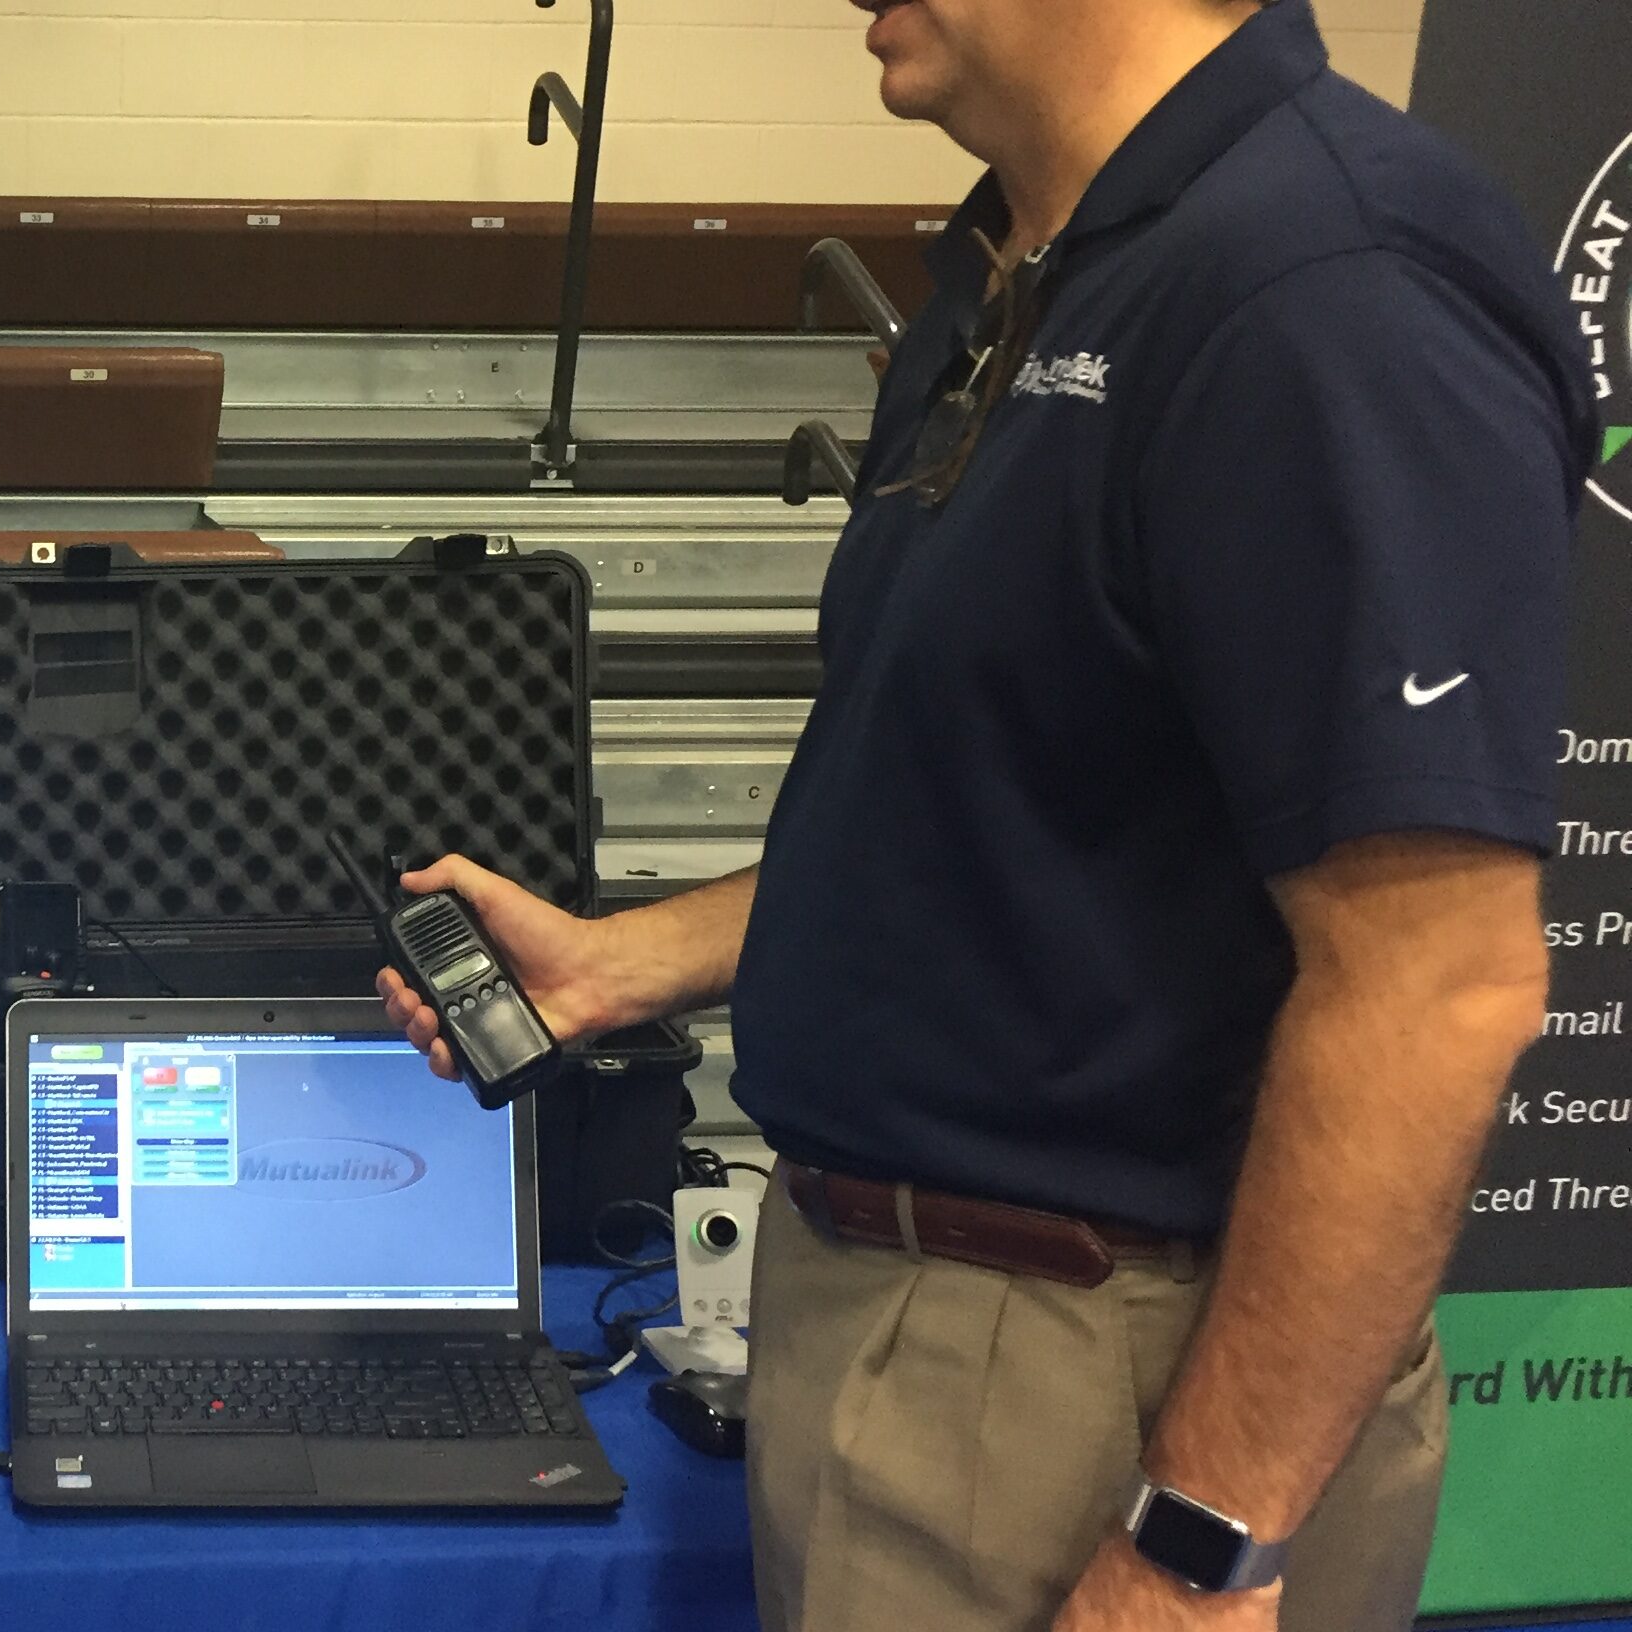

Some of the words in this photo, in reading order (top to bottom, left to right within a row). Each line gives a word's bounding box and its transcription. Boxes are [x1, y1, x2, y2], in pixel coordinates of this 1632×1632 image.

[633, 561, 644, 574] D
[748, 785, 760, 799] C
[239, 1157, 399, 1182] Mutualink
[1472, 1179, 1536, 1212] ced
[1549, 1178, 1632, 1210] Thre
[1523, 1356, 1632, 1403] With
